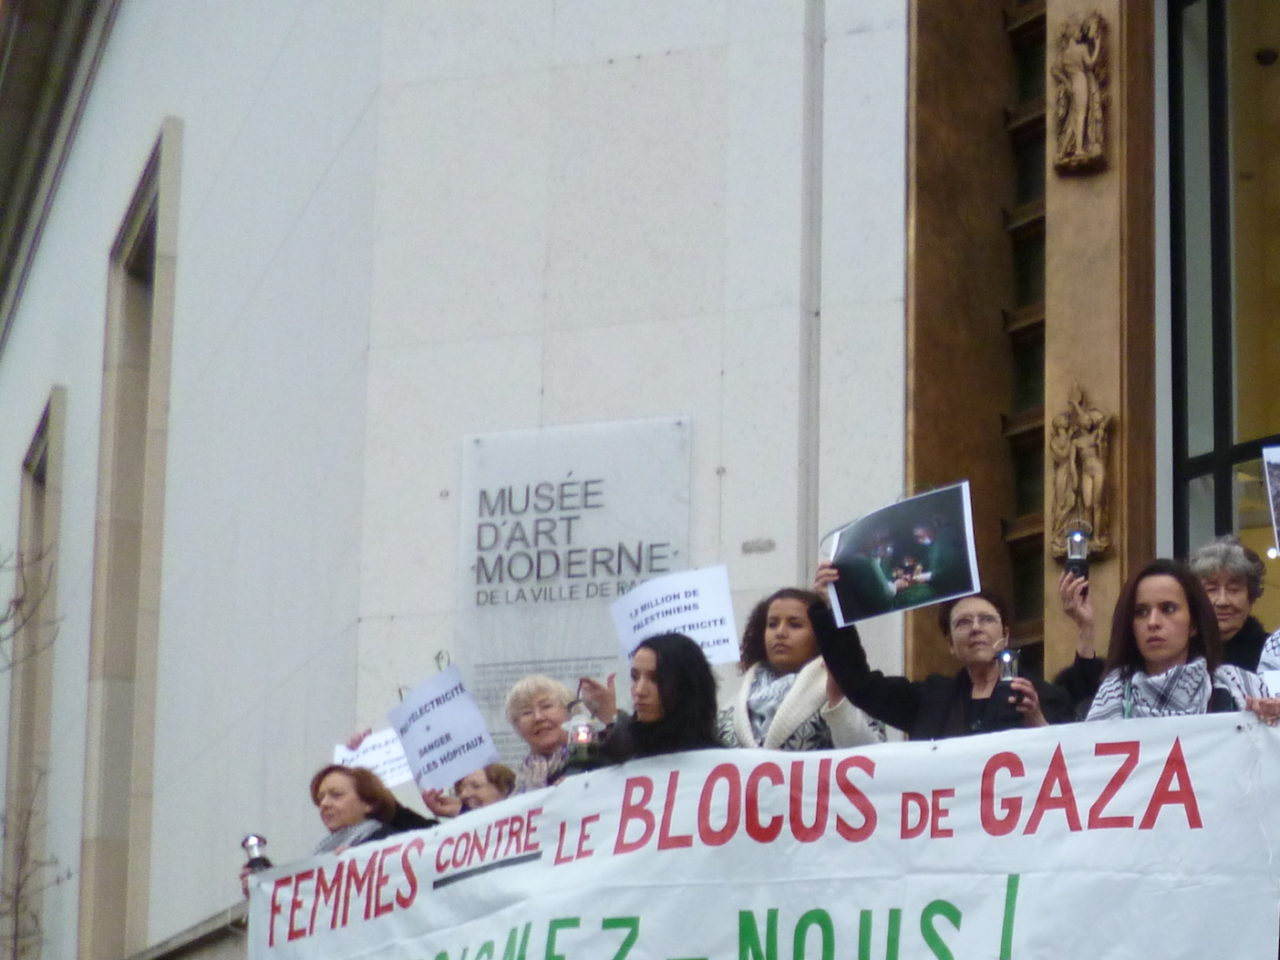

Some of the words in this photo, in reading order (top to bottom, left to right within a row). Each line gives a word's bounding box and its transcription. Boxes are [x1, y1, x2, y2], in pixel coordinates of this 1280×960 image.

[478, 471, 604, 517] MUSÉE
[477, 515, 580, 551] D'ART
[475, 541, 671, 585] MODERNE
[476, 588, 499, 606] DE
[505, 584, 528, 604] LA
[530, 583, 581, 602] VILLE
[586, 580, 612, 598] DE
[684, 588, 699, 600] DE
[268, 838, 424, 948] FEMMES
[434, 807, 543, 874] CONTRE
[553, 814, 600, 866] LE
[612, 754, 878, 856] BLOCUS
[900, 788, 956, 840] DE
[980, 735, 1204, 837] GAZA
